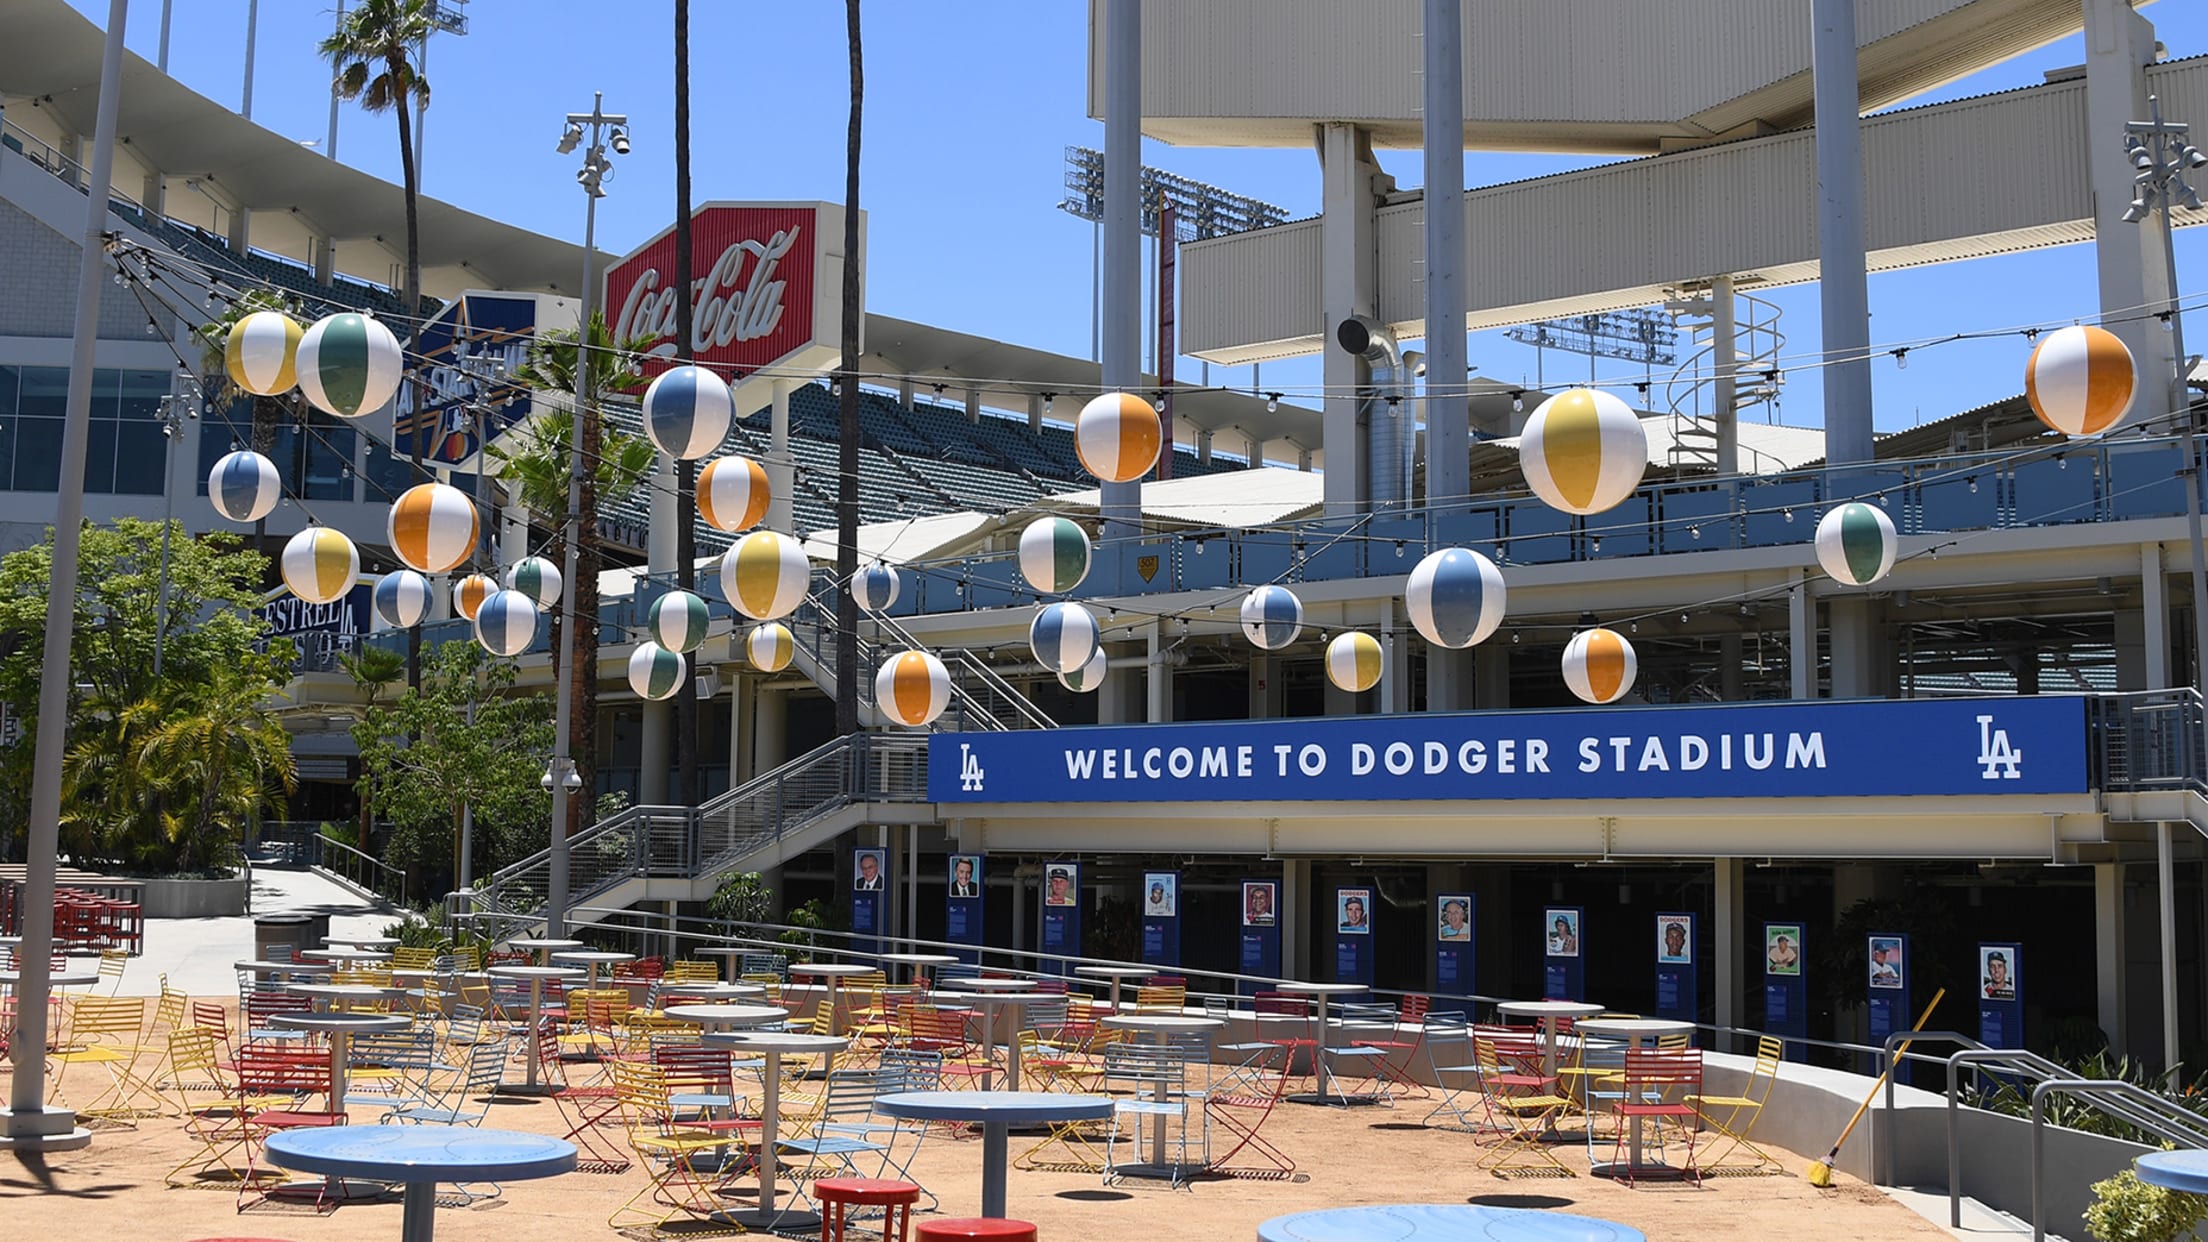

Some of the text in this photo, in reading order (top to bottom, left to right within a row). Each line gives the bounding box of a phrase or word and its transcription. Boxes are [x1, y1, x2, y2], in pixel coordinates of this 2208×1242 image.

[960, 743, 984, 791] LA
[1065, 732, 1827, 779] WELCOME TO DODGER STADIUM
[1977, 715, 2022, 779] LA
